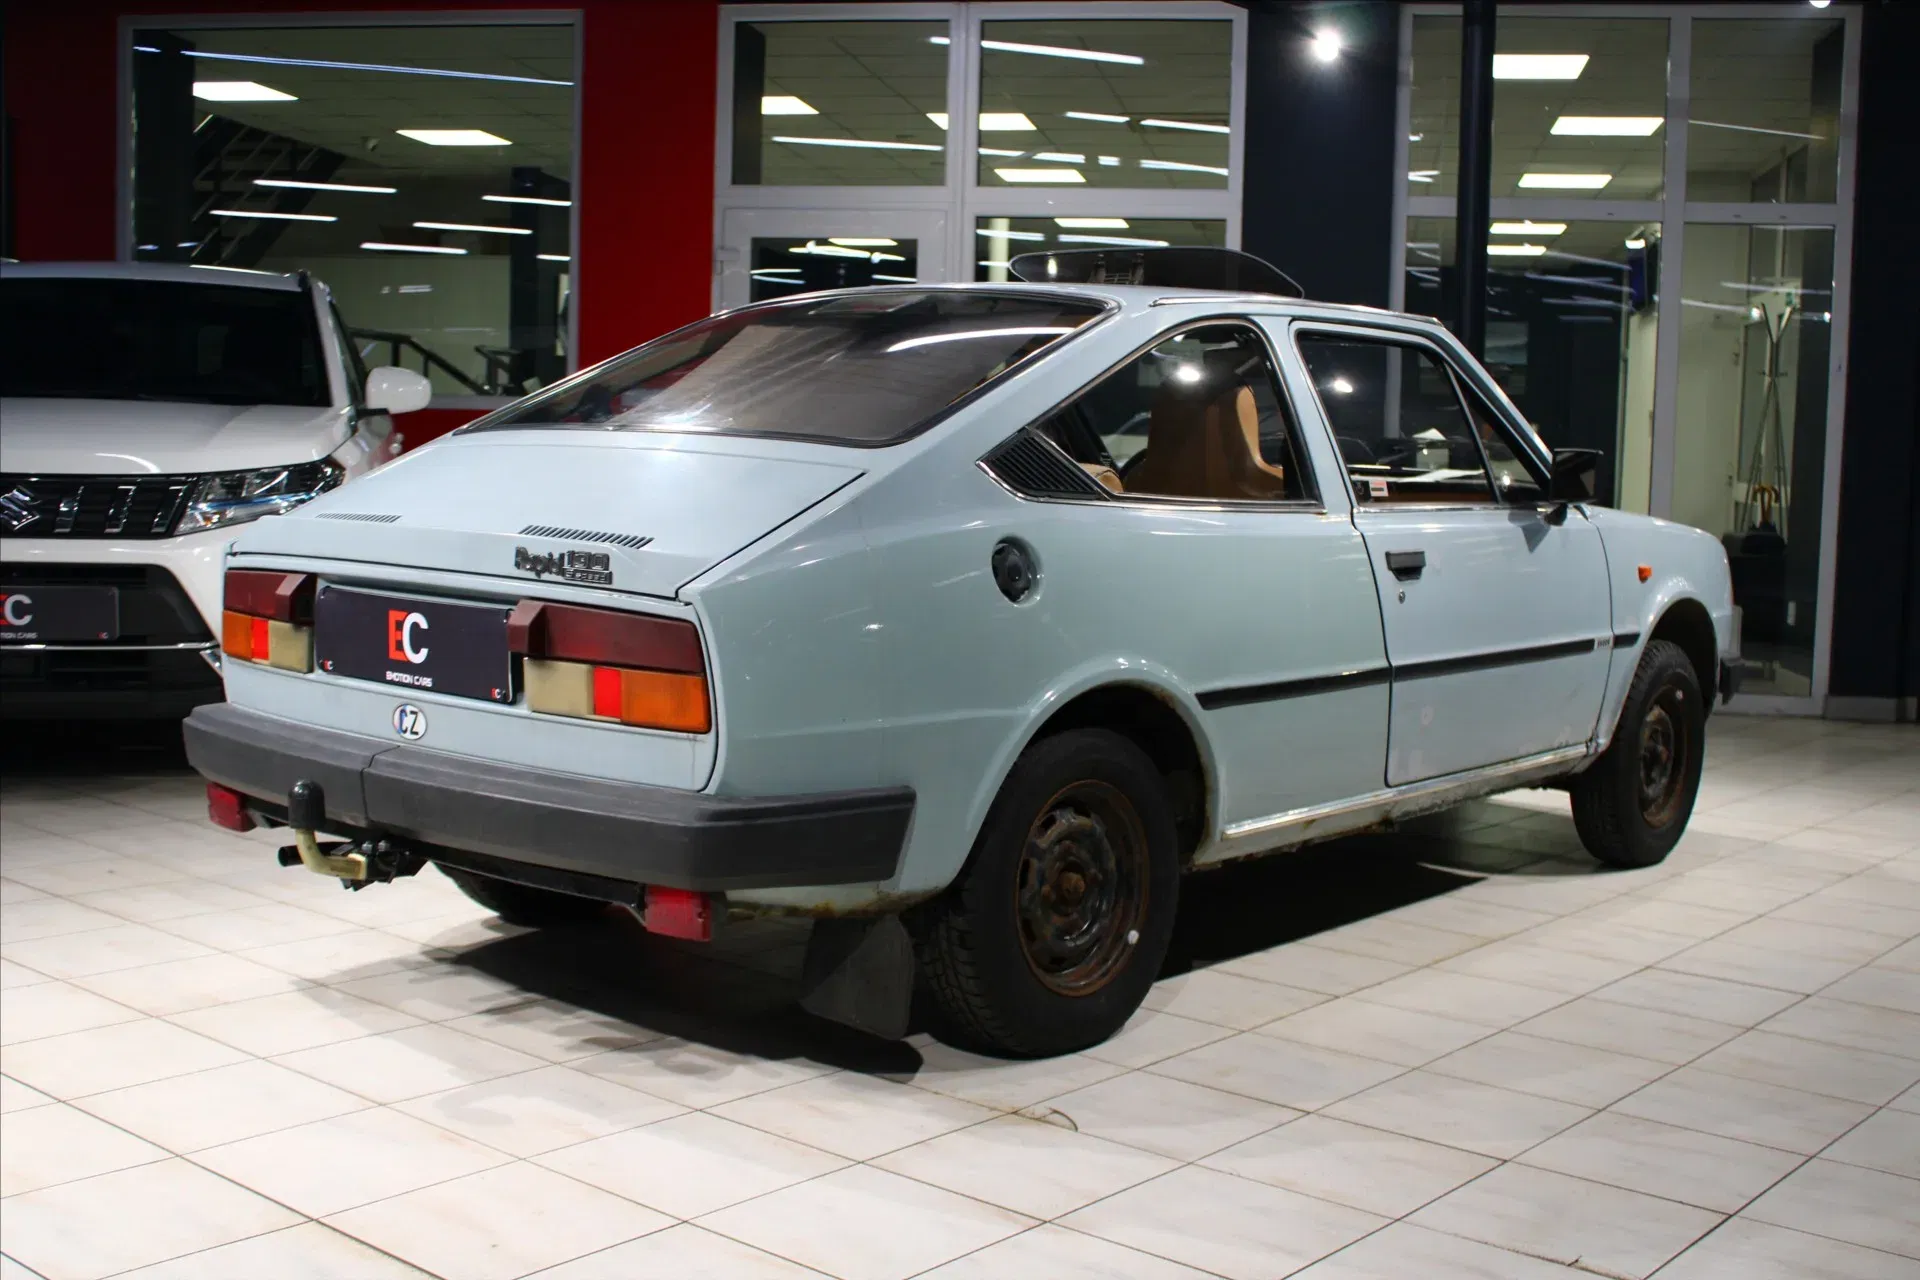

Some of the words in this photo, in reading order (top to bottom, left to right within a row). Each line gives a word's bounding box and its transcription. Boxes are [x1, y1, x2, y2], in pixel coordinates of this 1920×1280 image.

[388, 609, 429, 664] EC
[414, 676, 433, 688] CARS
[399, 708, 419, 736] CZ
